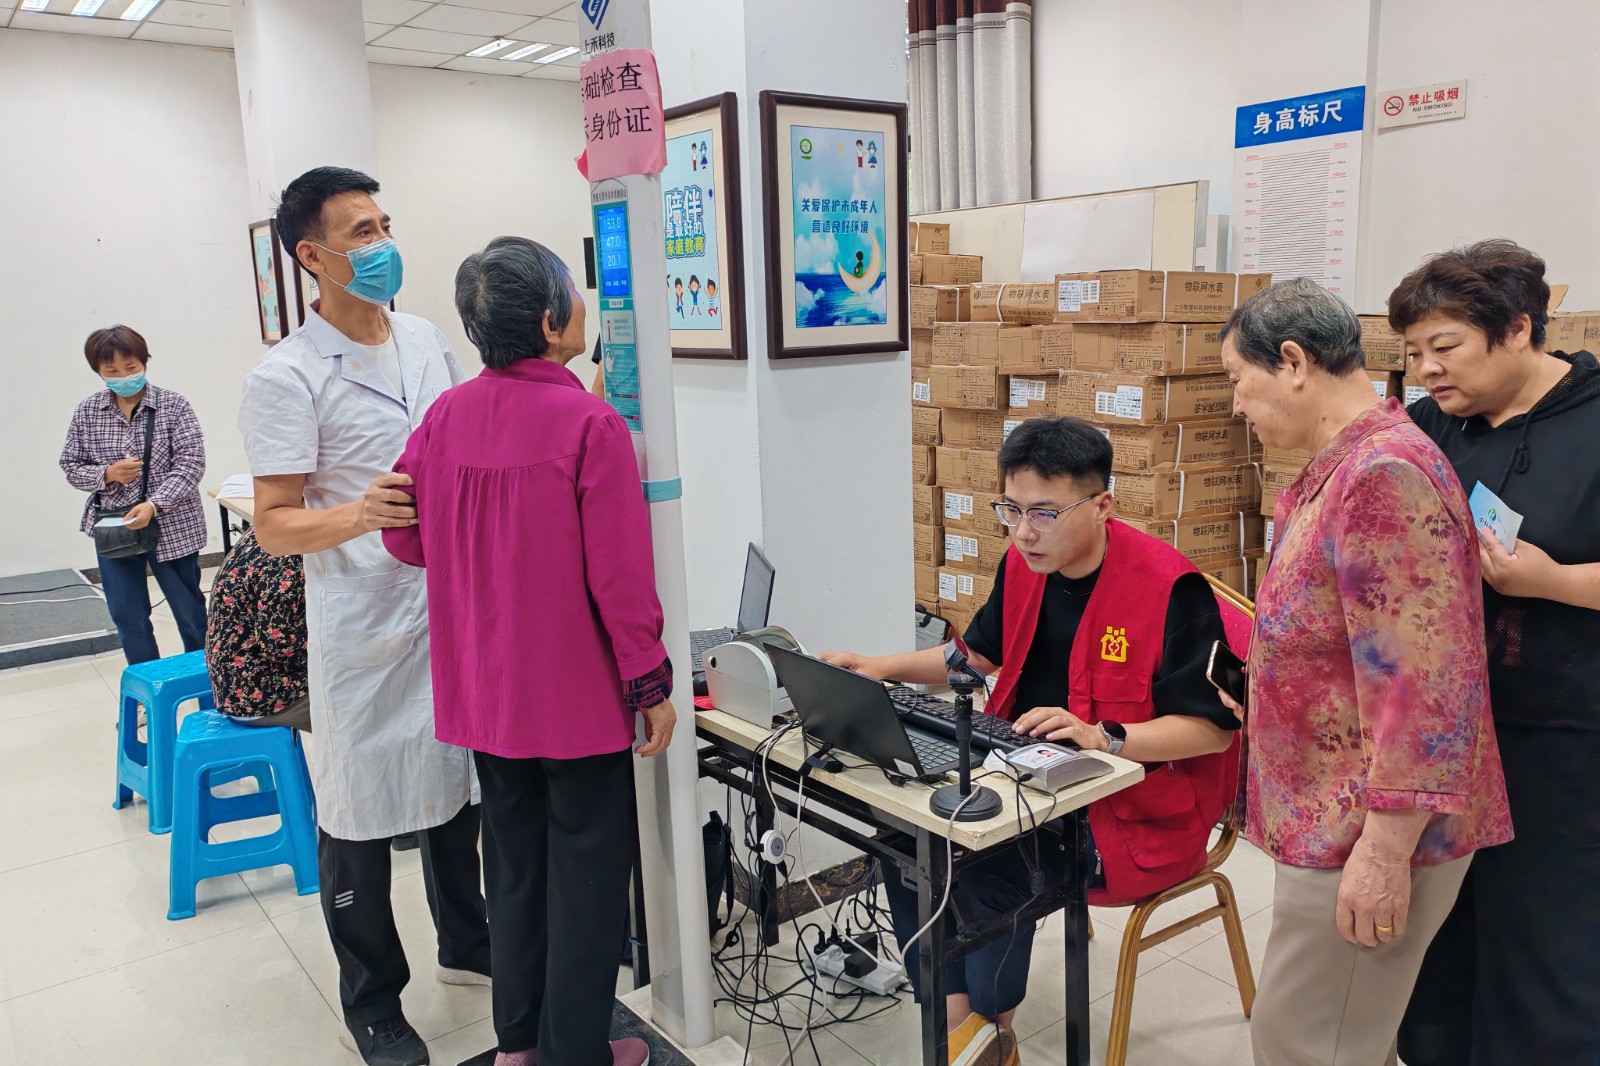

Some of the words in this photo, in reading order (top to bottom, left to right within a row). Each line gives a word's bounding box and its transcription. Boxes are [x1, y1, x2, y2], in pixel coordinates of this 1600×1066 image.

[584, 32, 616, 55] 上禾科技
[1408, 87, 1459, 107] 禁止吸烟
[1424, 102, 1453, 111] SMOKING
[1253, 99, 1343, 136] 身高标尺
[666, 188, 702, 222] 陪伴
[802, 198, 878, 214] 关爱保护未成年人
[603, 217, 621, 230] 153.0
[812, 220, 869, 234] 营造良好环境
[666, 222, 702, 239] 是最好的
[606, 236, 621, 248] 47.0
[666, 237, 705, 256] 家庭教育
[608, 254, 621, 267] 20.1
[1185, 281, 1224, 293] 物联网水表
[1009, 289, 1050, 299] 物联网水表
[1194, 430, 1229, 442] 物联网水表
[1203, 475, 1243, 487] 物联网水表
[1193, 523, 1231, 536] 物联网水表
